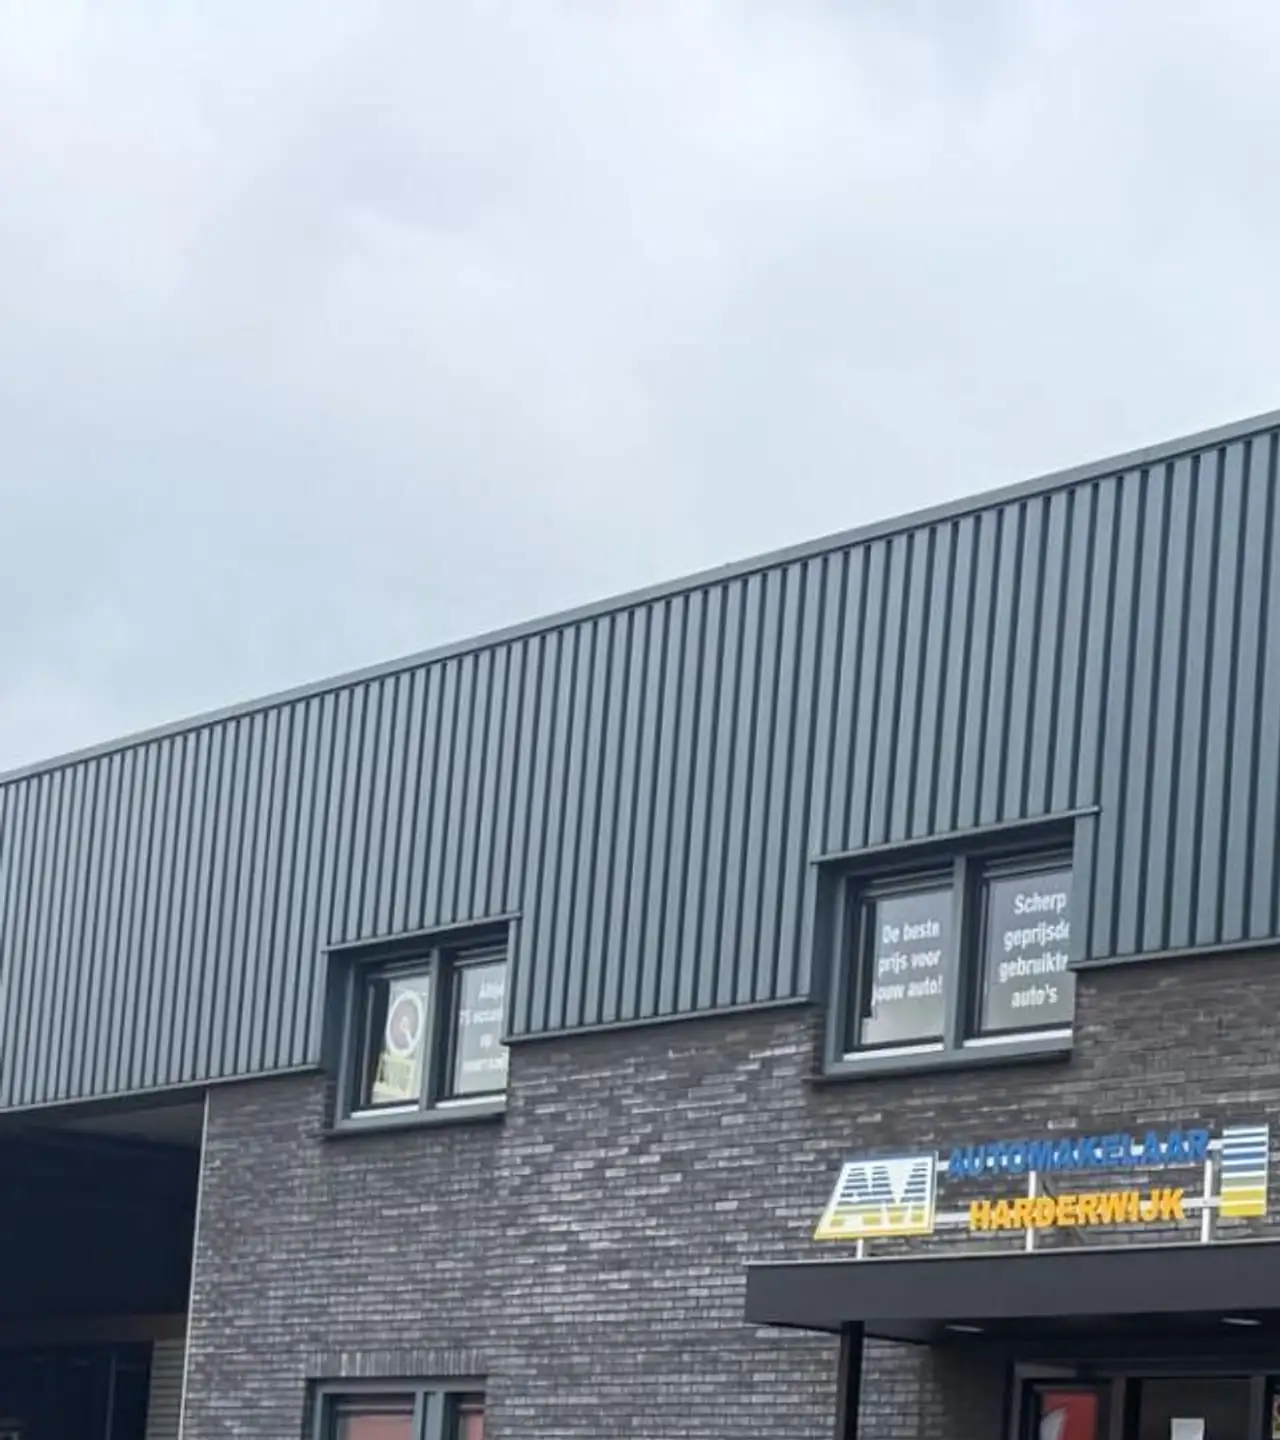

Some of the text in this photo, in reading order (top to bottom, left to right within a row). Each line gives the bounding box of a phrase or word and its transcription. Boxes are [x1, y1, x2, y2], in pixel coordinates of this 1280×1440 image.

[1013, 892, 1067, 915] Scherp
[903, 919, 940, 941] beste
[878, 951, 908, 978] prijs
[1011, 984, 1058, 1008] auto's
[947, 1128, 1210, 1178] AUTOMAKELAAR
[968, 1187, 1185, 1231] HARDERWIJK
